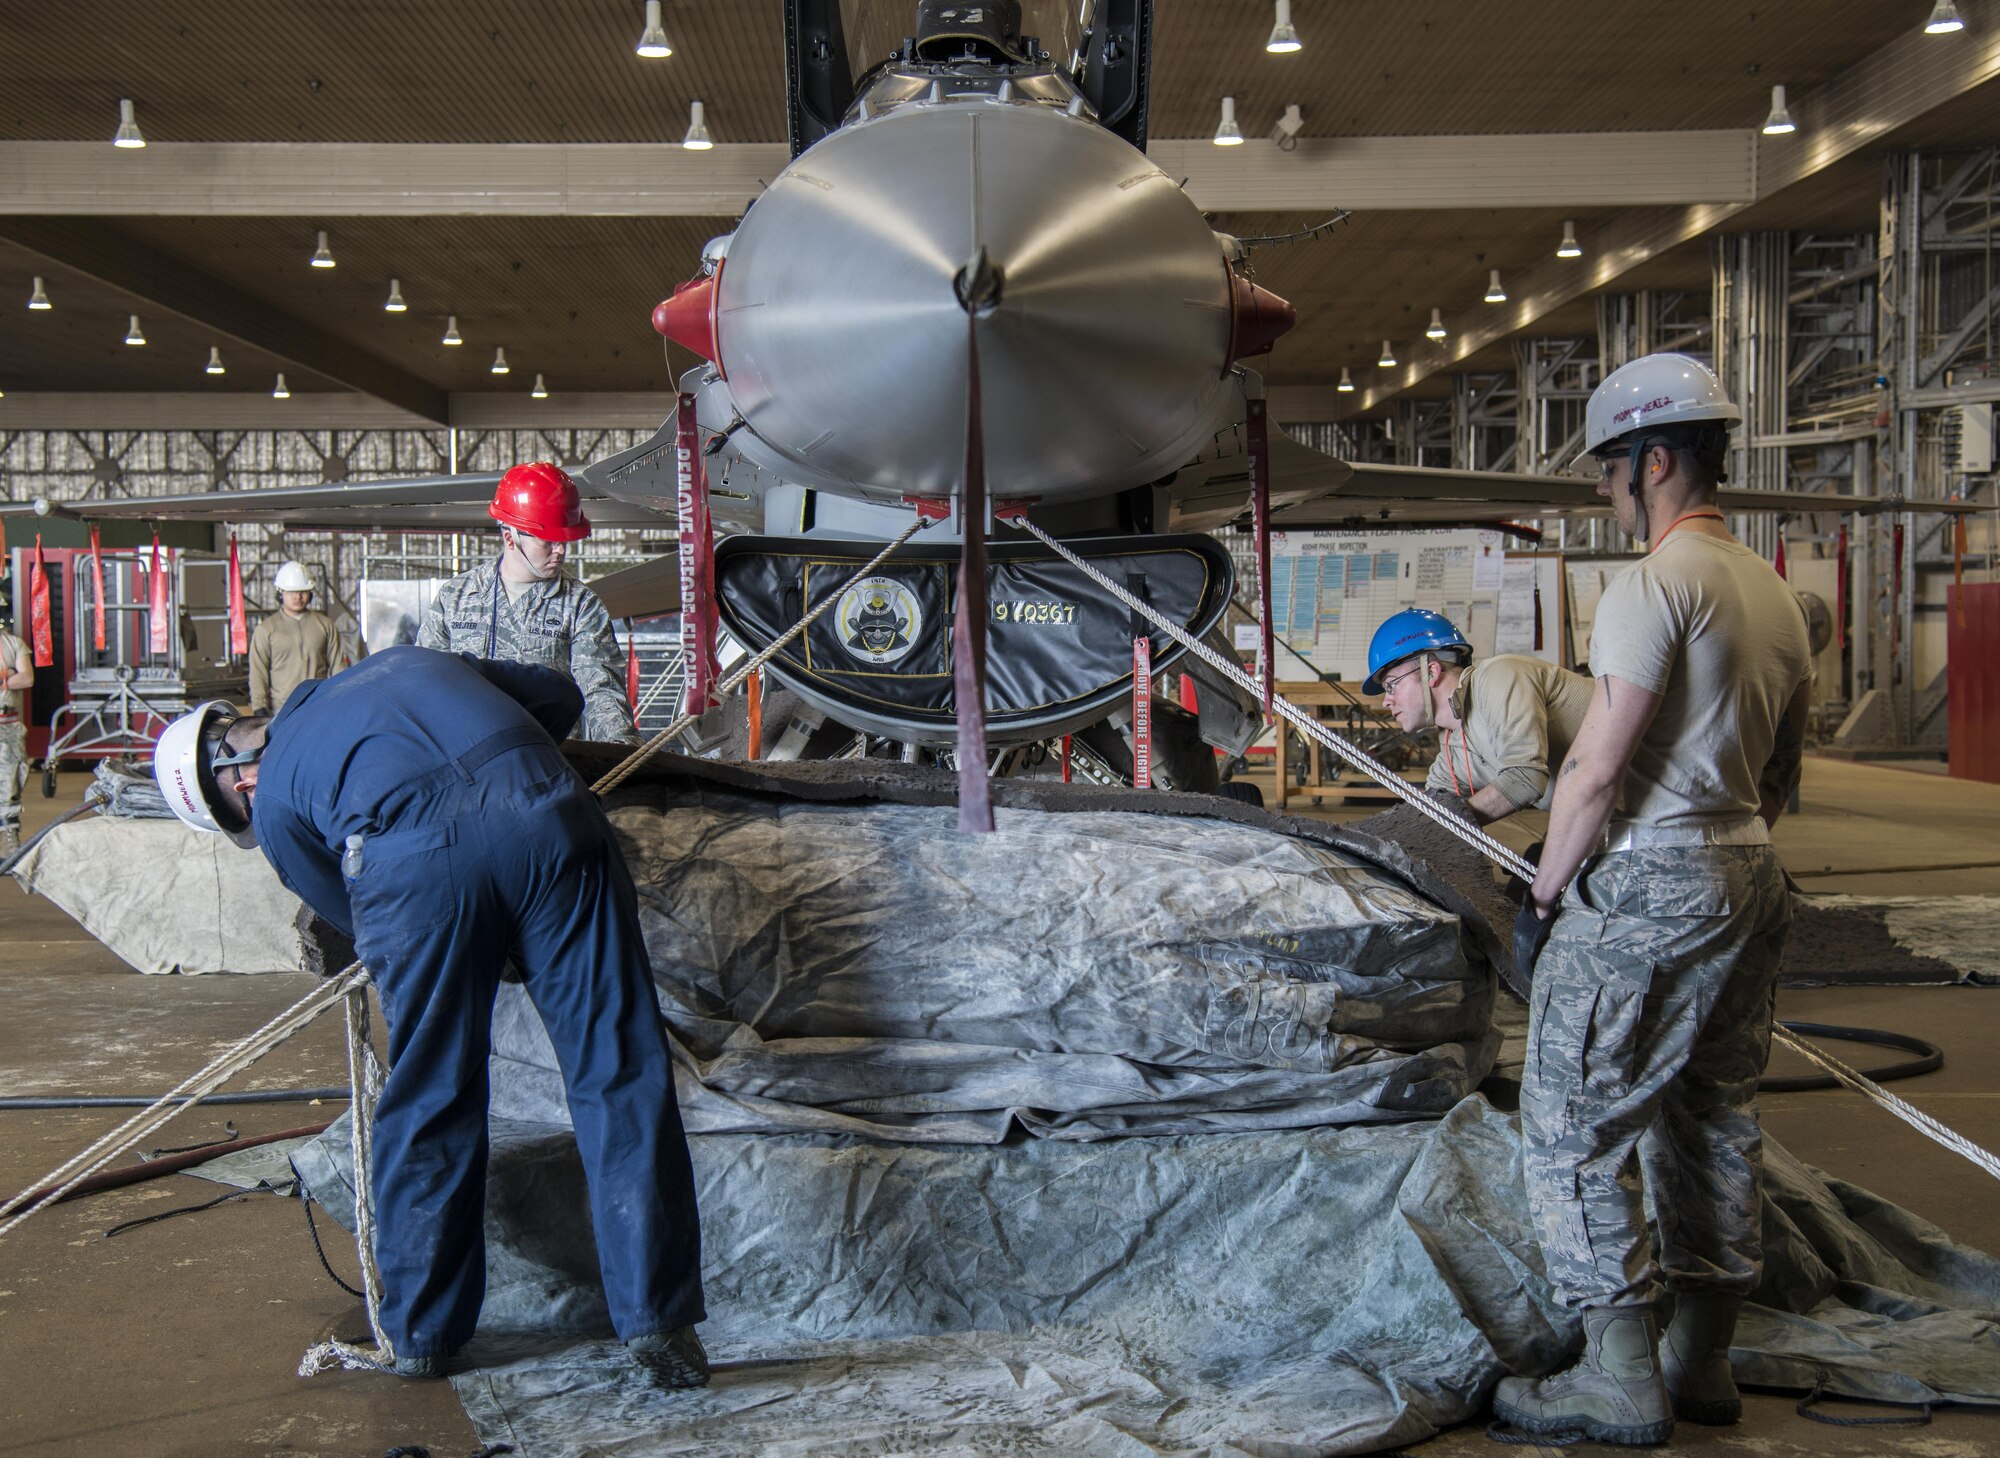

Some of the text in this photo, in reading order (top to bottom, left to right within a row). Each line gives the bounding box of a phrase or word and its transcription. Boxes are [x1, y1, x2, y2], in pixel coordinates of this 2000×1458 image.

[541, 628, 553, 638] AIR
[1137, 654, 1148, 784] REMOVE BEFORE FLIGHT!
